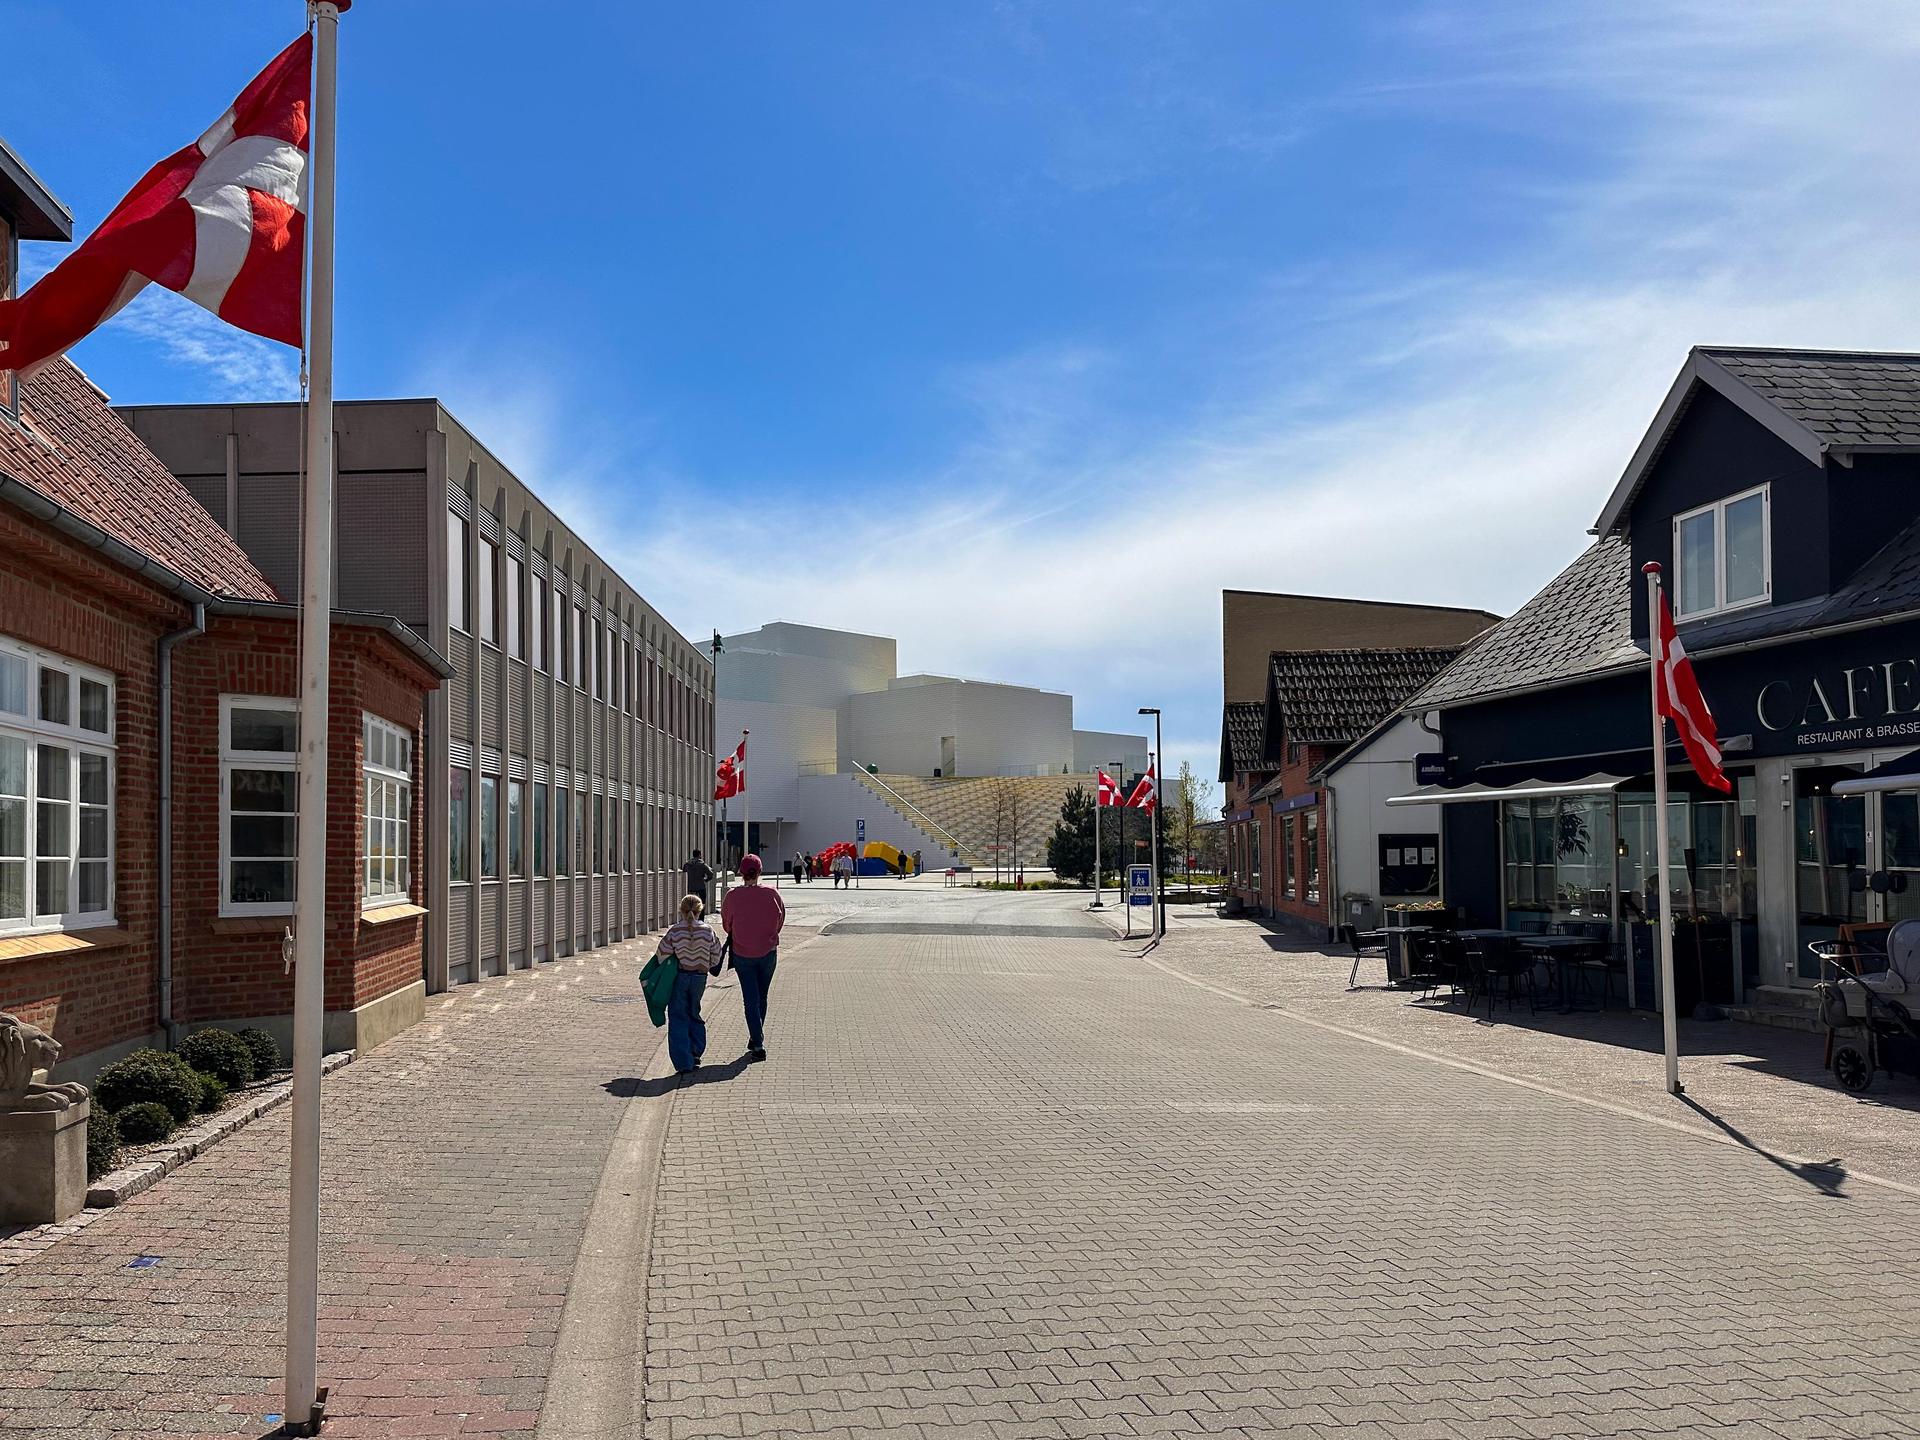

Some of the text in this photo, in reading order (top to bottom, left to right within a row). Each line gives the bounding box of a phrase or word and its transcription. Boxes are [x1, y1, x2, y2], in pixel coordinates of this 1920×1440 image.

[1757, 658, 1920, 731] CAFE
[1797, 721, 1920, 745] RESTAURANT & BRASSE
[858, 821, 864, 829] P
